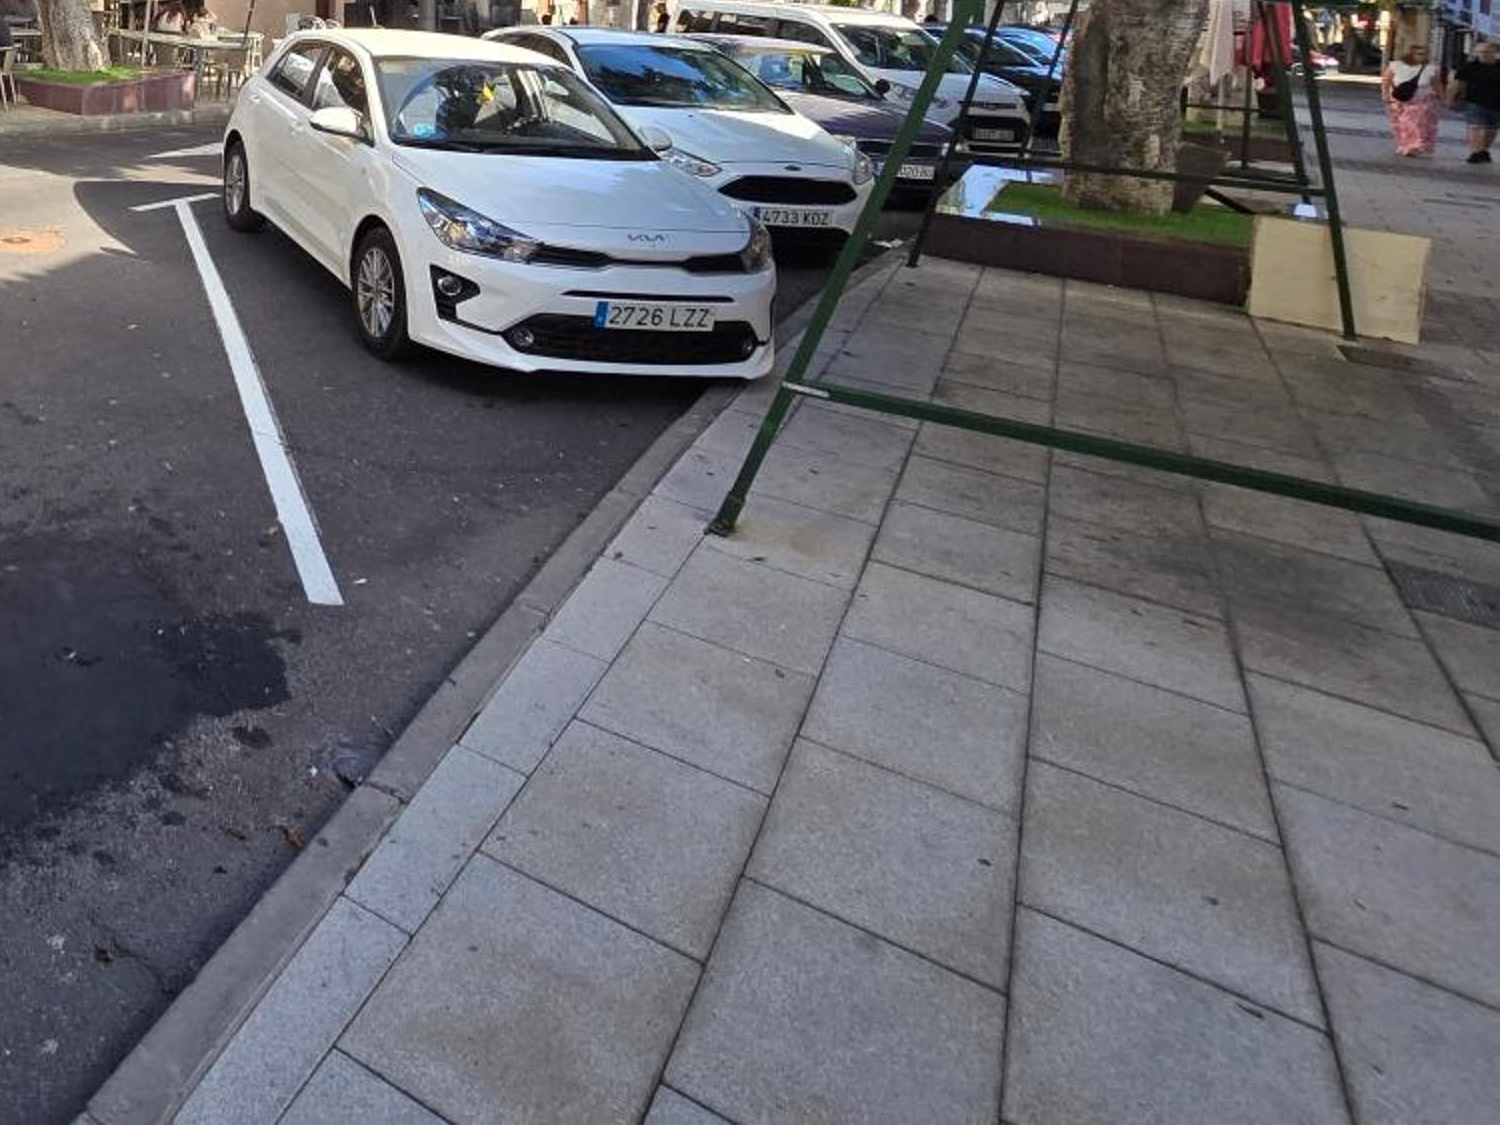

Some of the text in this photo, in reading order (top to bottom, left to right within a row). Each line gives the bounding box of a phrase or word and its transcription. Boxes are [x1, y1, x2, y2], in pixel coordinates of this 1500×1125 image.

[763, 211, 799, 225] 4733
[608, 306, 709, 328] 2726 LZZ
